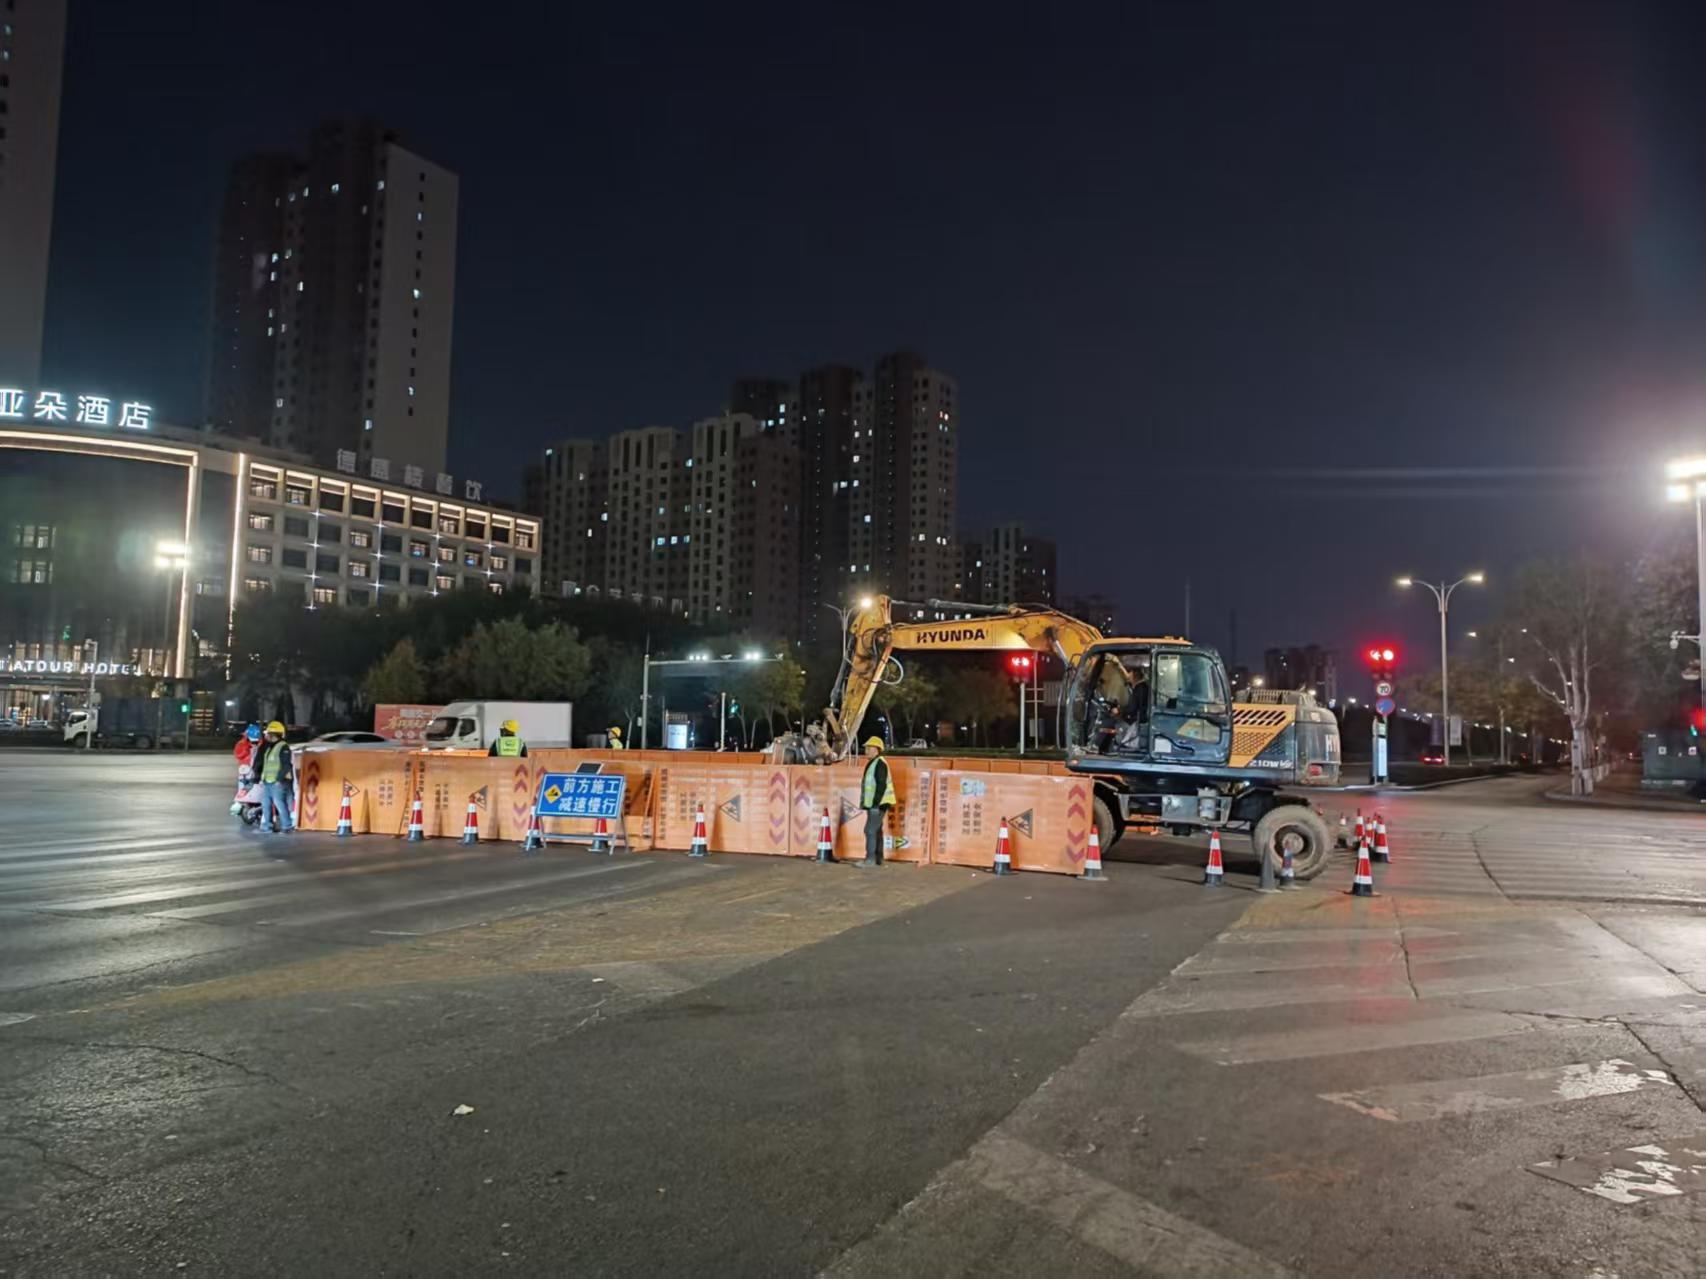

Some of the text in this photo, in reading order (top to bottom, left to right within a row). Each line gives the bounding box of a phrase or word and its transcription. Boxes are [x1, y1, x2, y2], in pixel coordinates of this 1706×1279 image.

[0, 388, 153, 429] 亚朵酒店
[14, 660, 74, 673] ATOUR
[562, 777, 619, 794] 前方施工
[558, 795, 616, 814] 减速慢行
